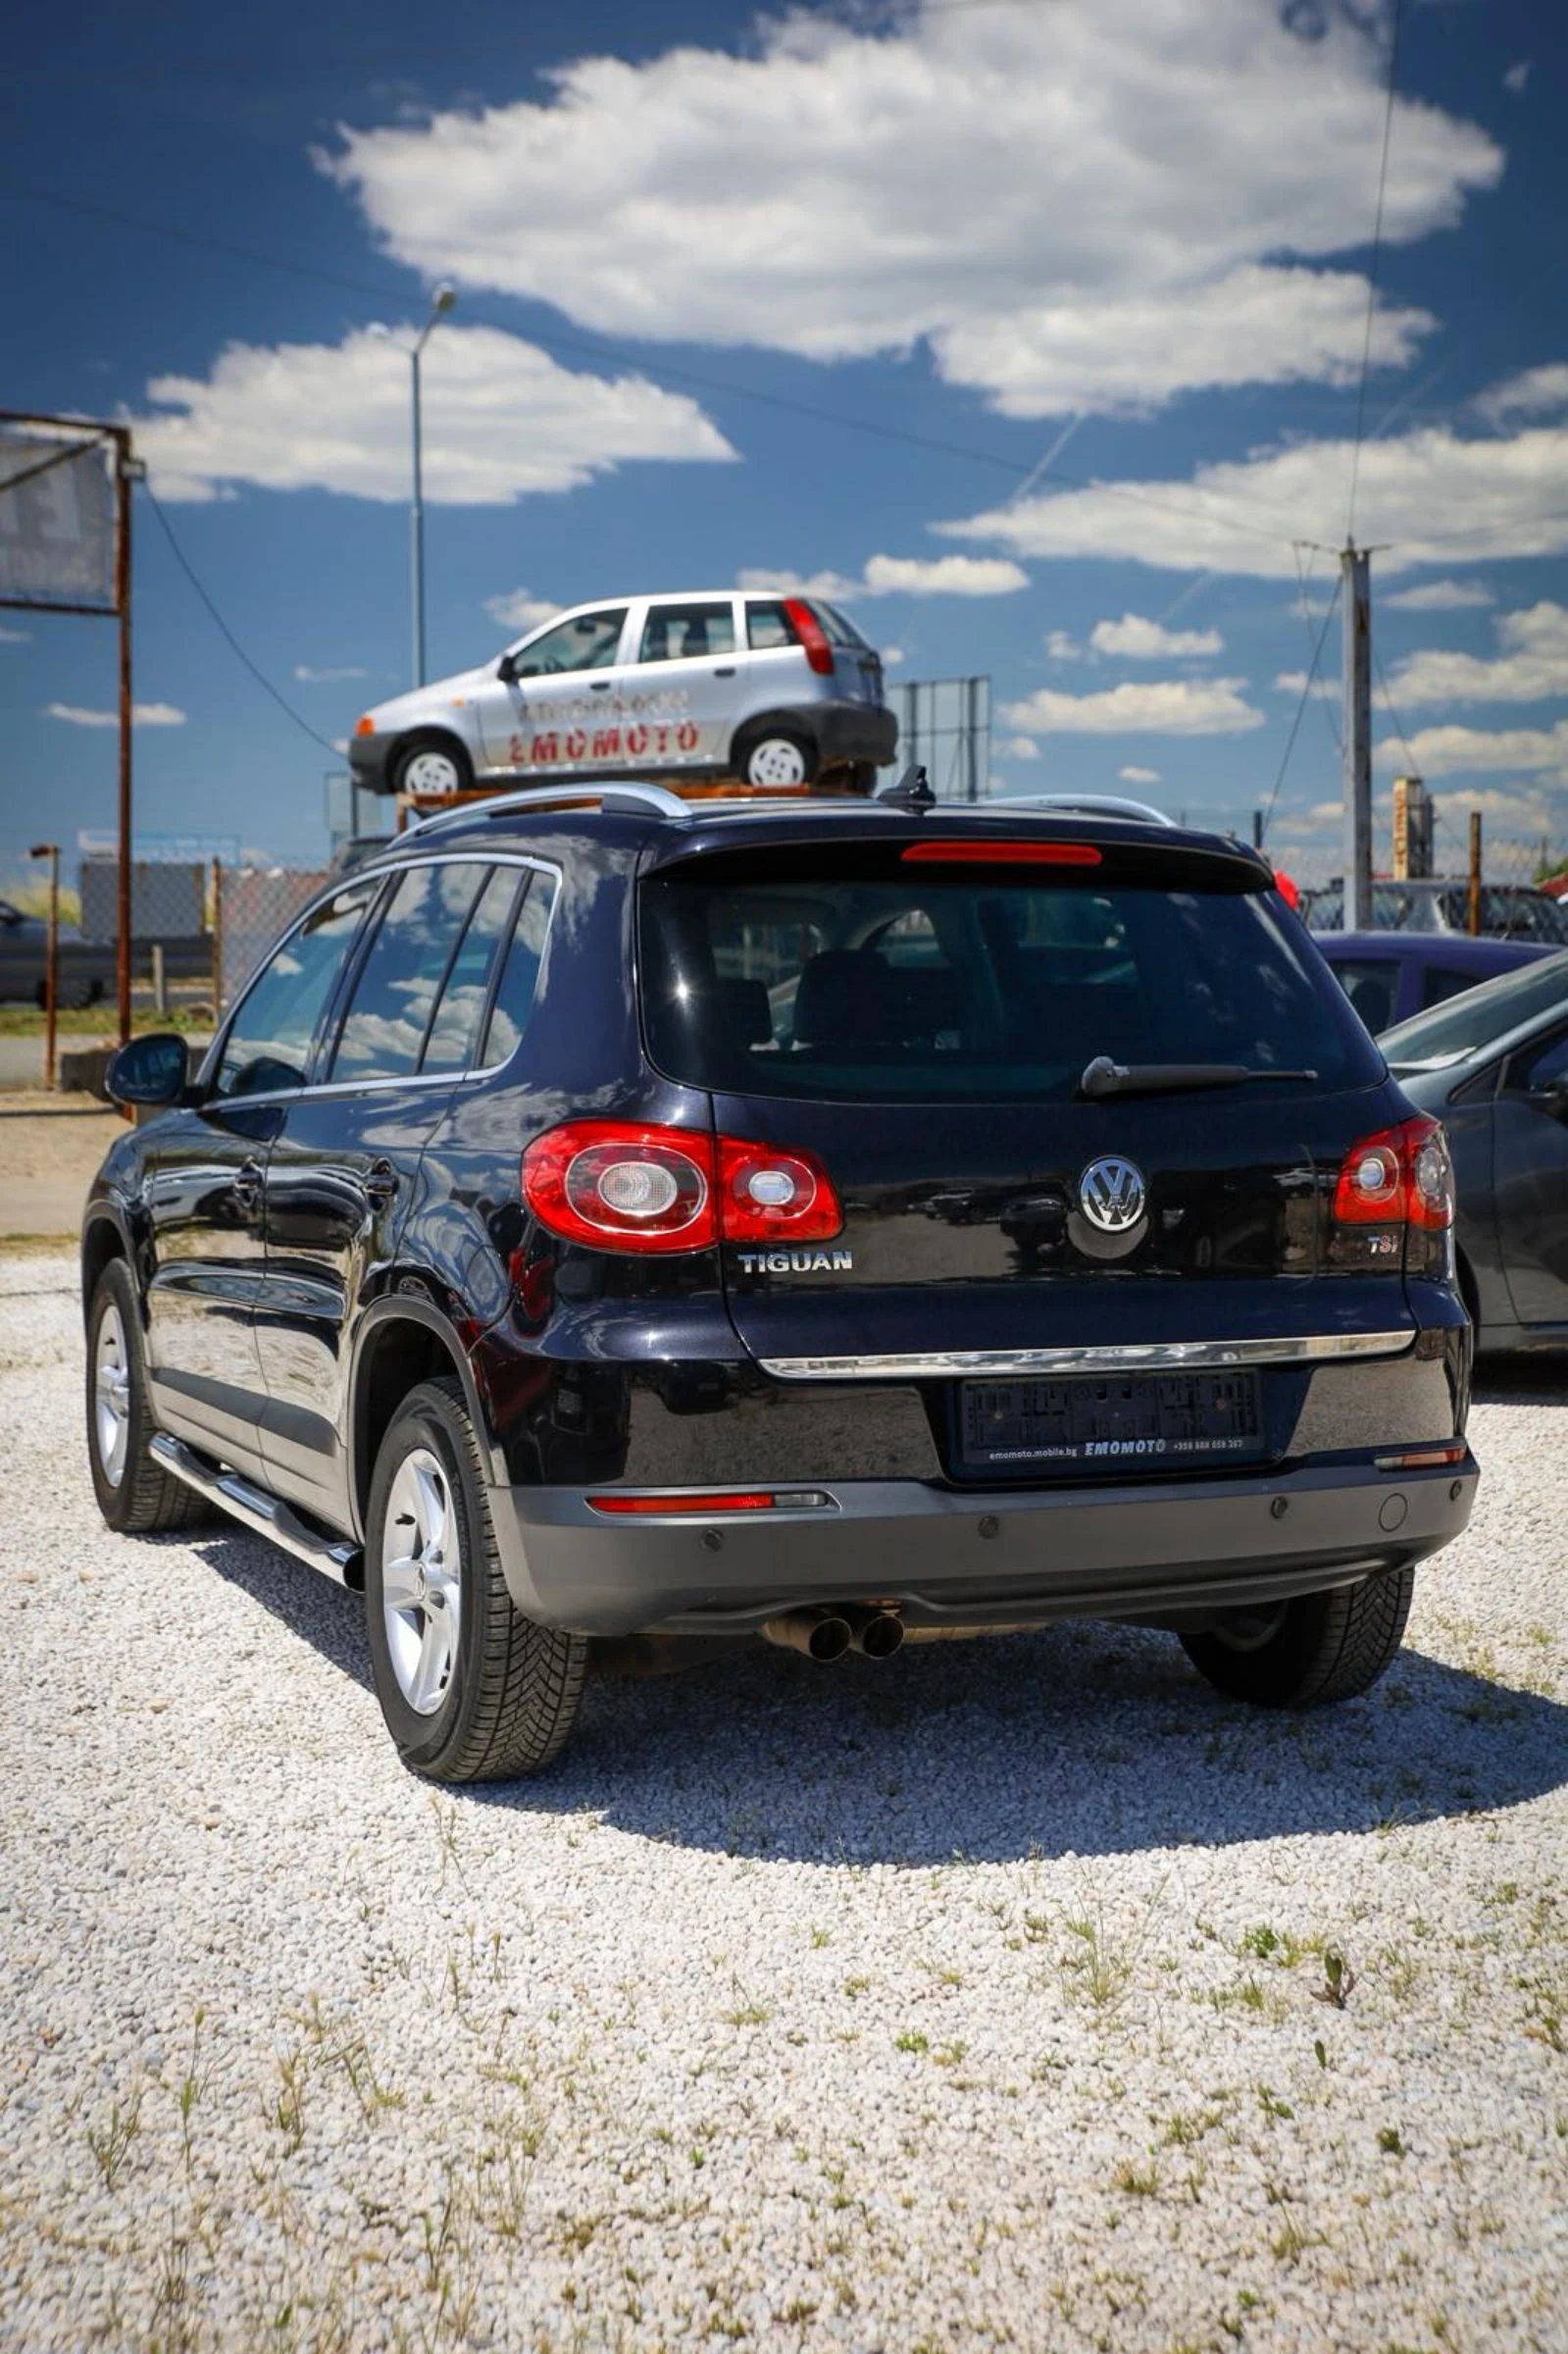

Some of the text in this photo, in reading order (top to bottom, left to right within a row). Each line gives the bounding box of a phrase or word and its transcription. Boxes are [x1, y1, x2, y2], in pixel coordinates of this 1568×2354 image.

[737, 1251, 853, 1273] TIGUAN
[988, 1447, 1078, 1460] emomoto.mobile.bg
[1085, 1439, 1166, 1457] EMOMOTO
